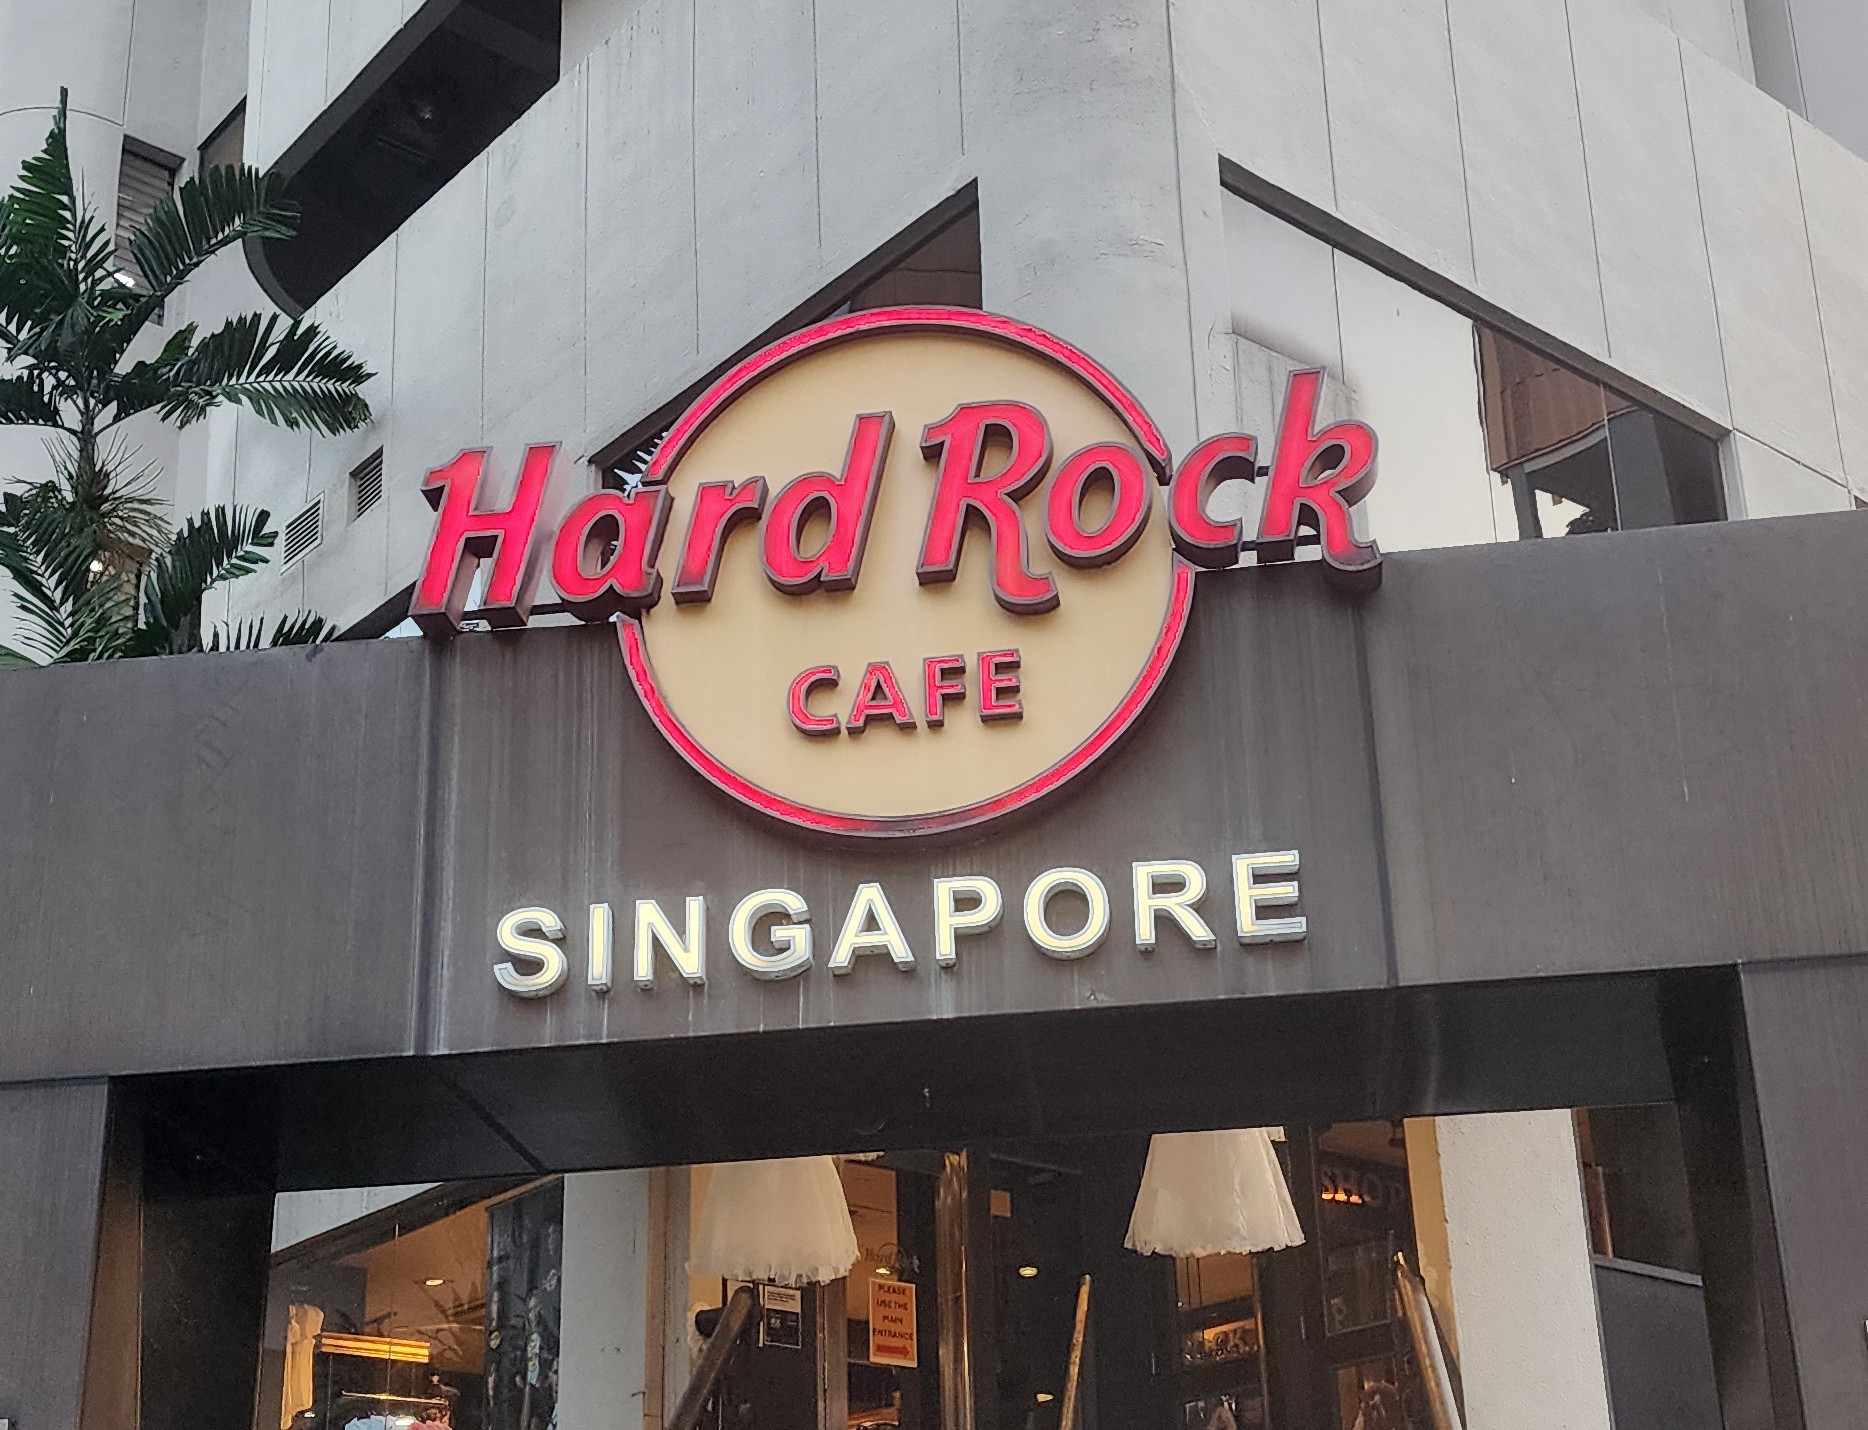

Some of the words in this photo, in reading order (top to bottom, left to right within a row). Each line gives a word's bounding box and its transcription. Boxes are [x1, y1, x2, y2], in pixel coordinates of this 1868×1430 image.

[409, 412, 893, 634] Hard
[918, 367, 1382, 614] Rock
[787, 649, 1024, 736] CAFE
[494, 850, 1307, 999] SINGAPORE
[878, 1284, 906, 1296] PLEASE
[876, 1299, 892, 1310] USE
[894, 1301, 908, 1311] THE
[883, 1315, 903, 1325] MAIN
[872, 1327, 914, 1341] ENTRANCE
